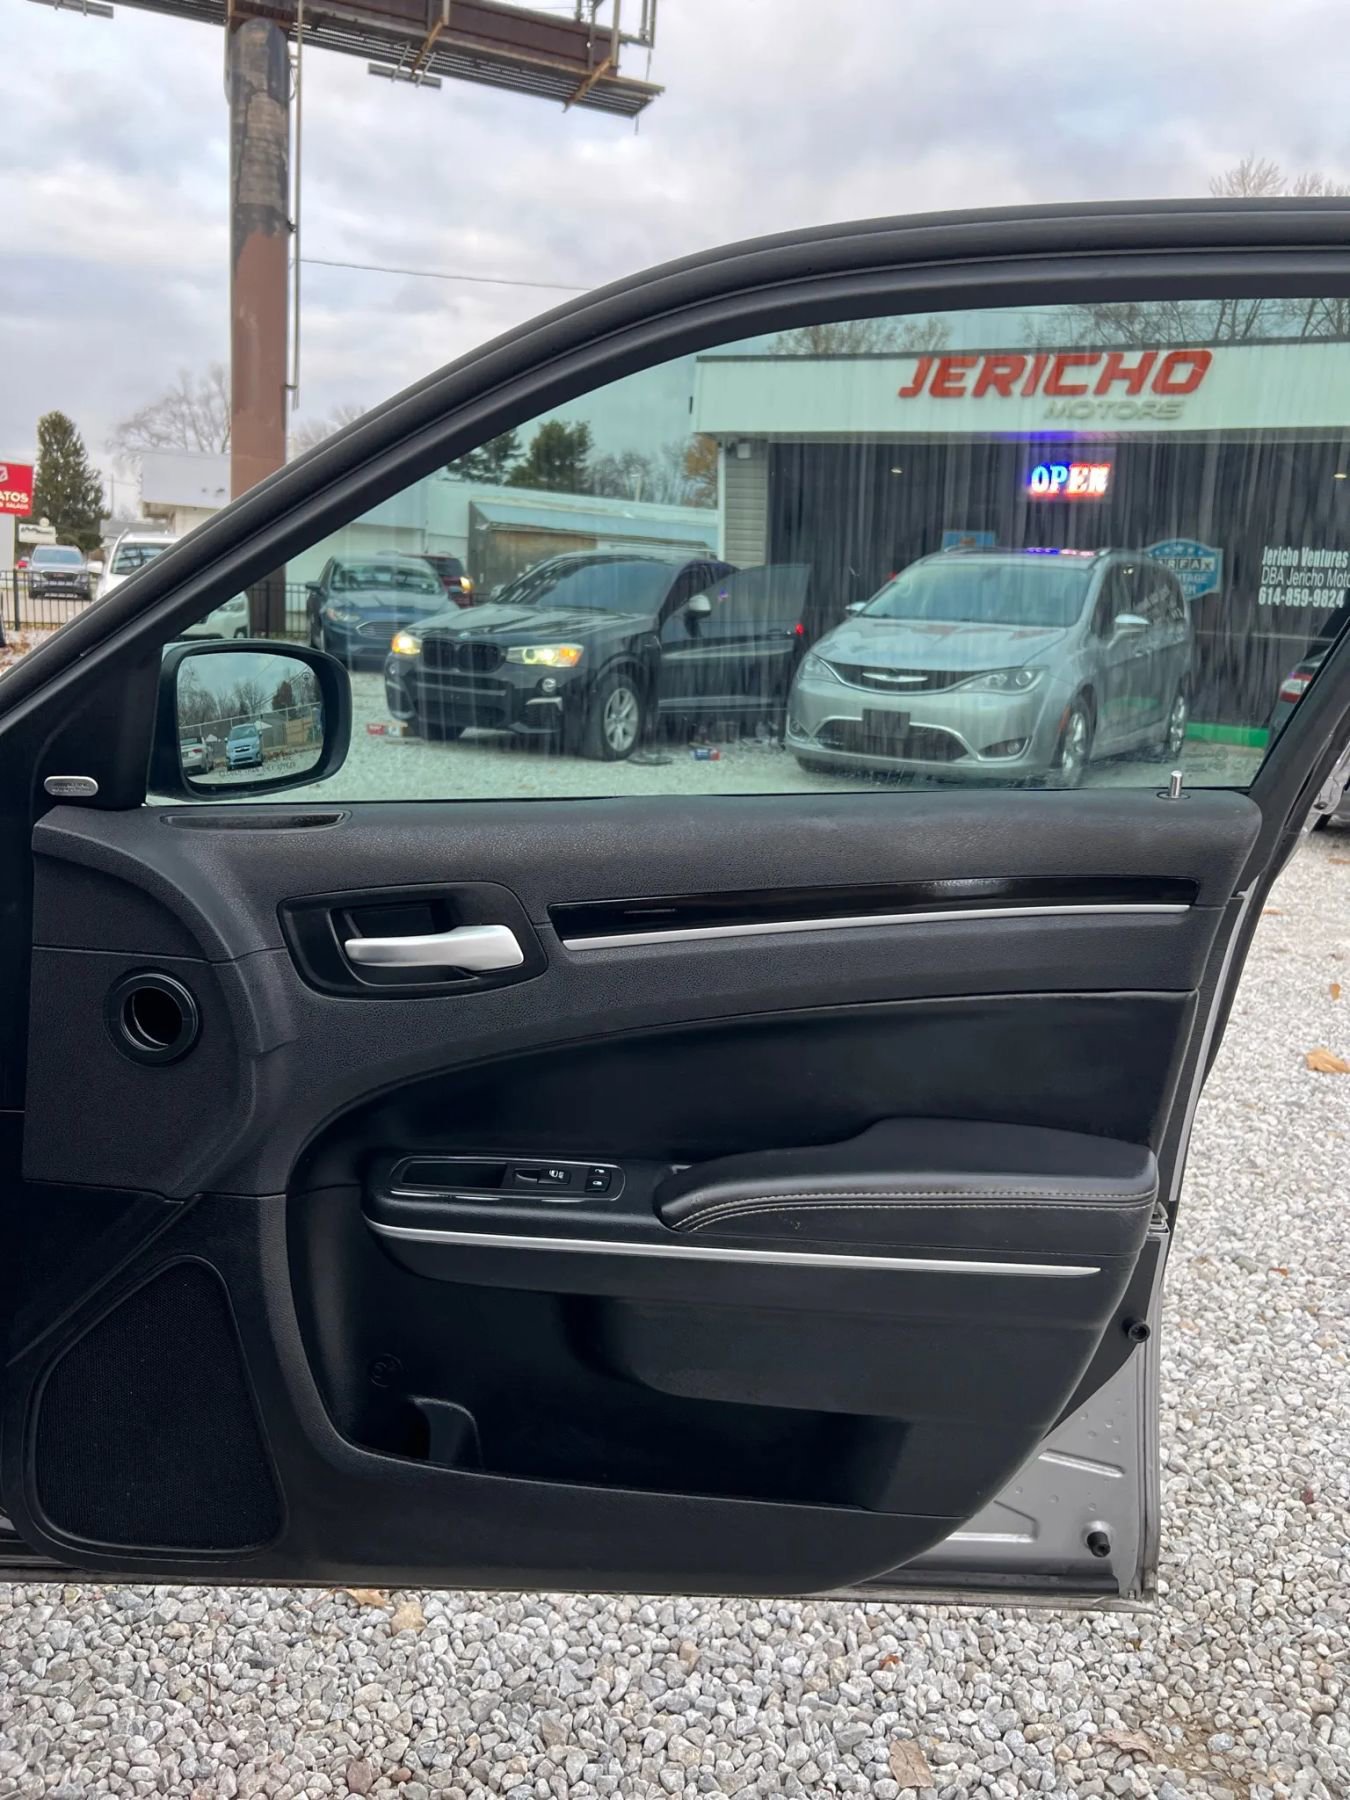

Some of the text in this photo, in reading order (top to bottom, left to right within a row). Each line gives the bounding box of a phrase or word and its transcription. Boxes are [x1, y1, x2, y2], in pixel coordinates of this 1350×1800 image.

[898, 350, 1213, 398] JERICHO
[1044, 400, 1185, 420] MOTORS
[1030, 463, 1111, 497] OPEN
[1262, 546, 1349, 569] Jericho Ventures
[1261, 566, 1285, 585] DBA
[1286, 567, 1325, 587] Jericho
[1258, 586, 1345, 609] 614-859-9824
